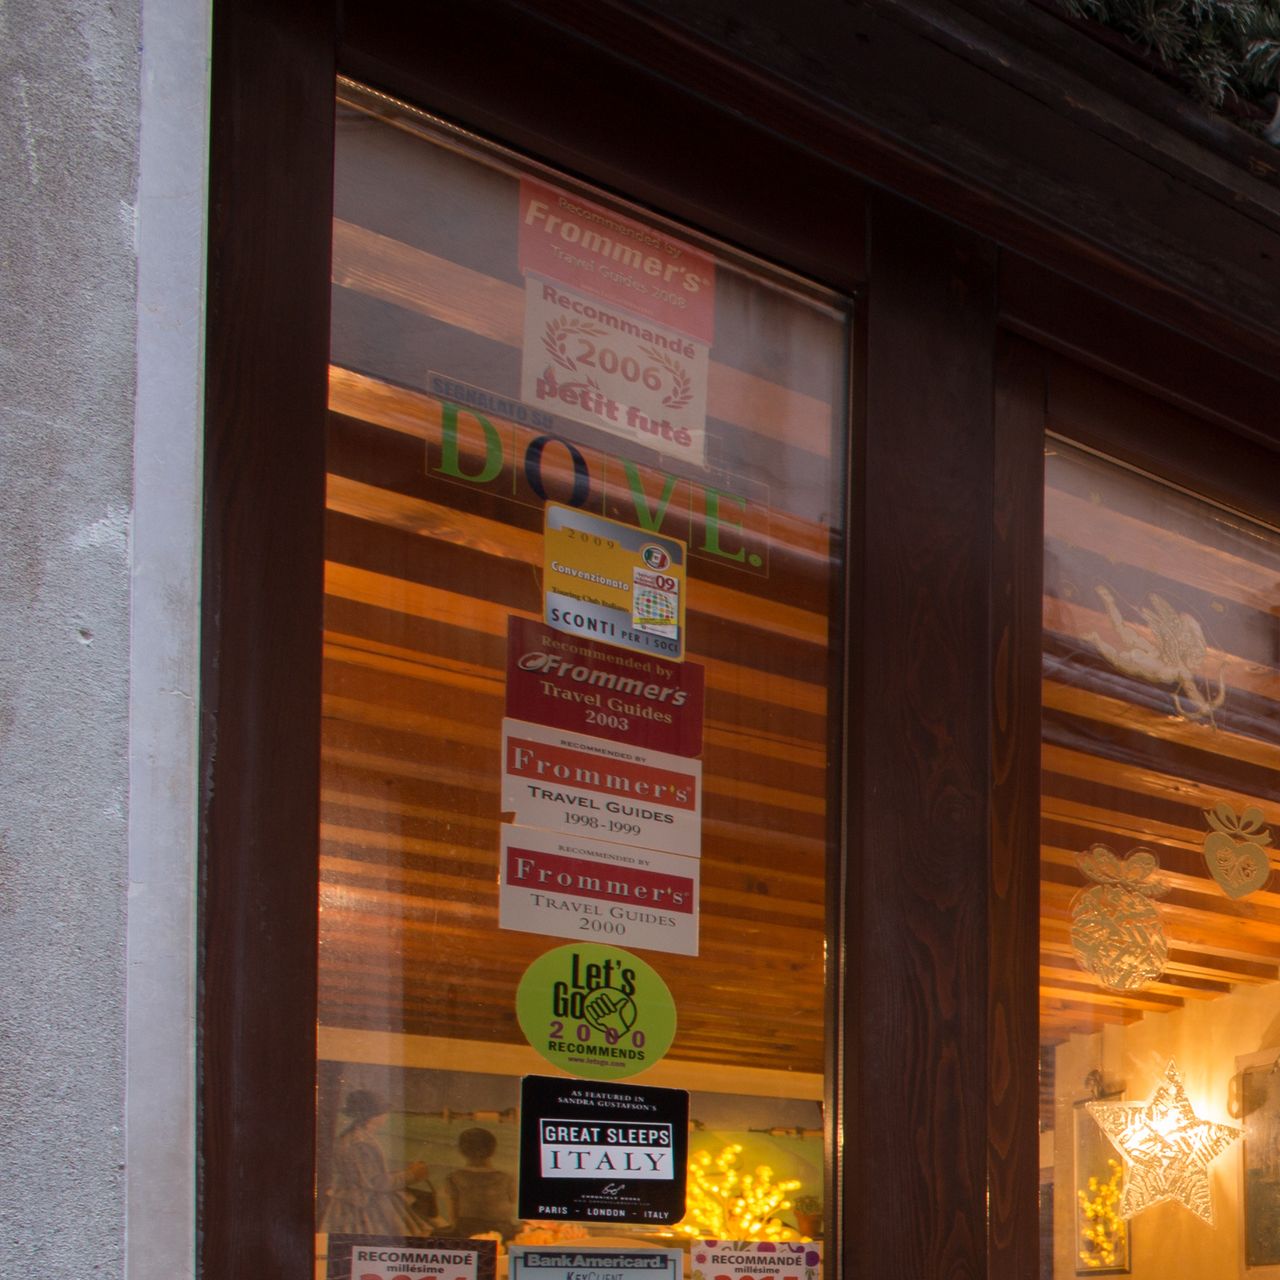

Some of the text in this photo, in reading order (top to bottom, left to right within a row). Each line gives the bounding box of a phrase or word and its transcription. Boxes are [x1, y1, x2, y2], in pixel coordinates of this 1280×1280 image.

[524, 199, 702, 293] Frommer's
[551, 245, 595, 272] Travel
[600, 265, 649, 295] Guides
[541, 284, 696, 360] Recommandé
[576, 338, 662, 391] 2006
[431, 377, 528, 425] SEGNALATO
[536, 376, 692, 448] petit futé
[568, 529, 615, 549] 2009
[551, 561, 630, 592] Convenzionato
[656, 575, 675, 590] 09
[552, 586, 581, 602] Touring
[582, 593, 601, 606] Club
[551, 608, 616, 637] SCONTI
[621, 630, 641, 643] PER
[654, 638, 679, 653] SOCI
[542, 635, 674, 681] Recommended by
[542, 654, 688, 707] Frommer's
[540, 680, 673, 725] Travel Guides
[584, 708, 629, 732] 2003
[560, 739, 647, 764] RECOMMENDED BY
[512, 746, 689, 804] Frommer's
[558, 844, 651, 868] RECOMMENDED BY
[514, 856, 684, 905] Frommer's
[578, 917, 627, 936] 2000
[571, 953, 636, 997] Let's
[549, 1020, 646, 1049] 2000
[548, 1040, 646, 1061] RECOMMENDS
[557, 1096, 657, 1112] SANDRA GUSTAFSON'S
[571, 1089, 583, 1098] AS
[585, 1091, 632, 1102] FEATURED
[545, 1126, 669, 1145] GREAT SLEEPS
[550, 1150, 666, 1172] ITALY
[538, 1205, 670, 1220] PARIS LONDON ITALY
[358, 1251, 473, 1265] RECOMMANDÉ
[386, 1264, 445, 1274] millésime
[711, 1254, 802, 1266] RECOMMANDÉ
[734, 1266, 781, 1275] millésime
